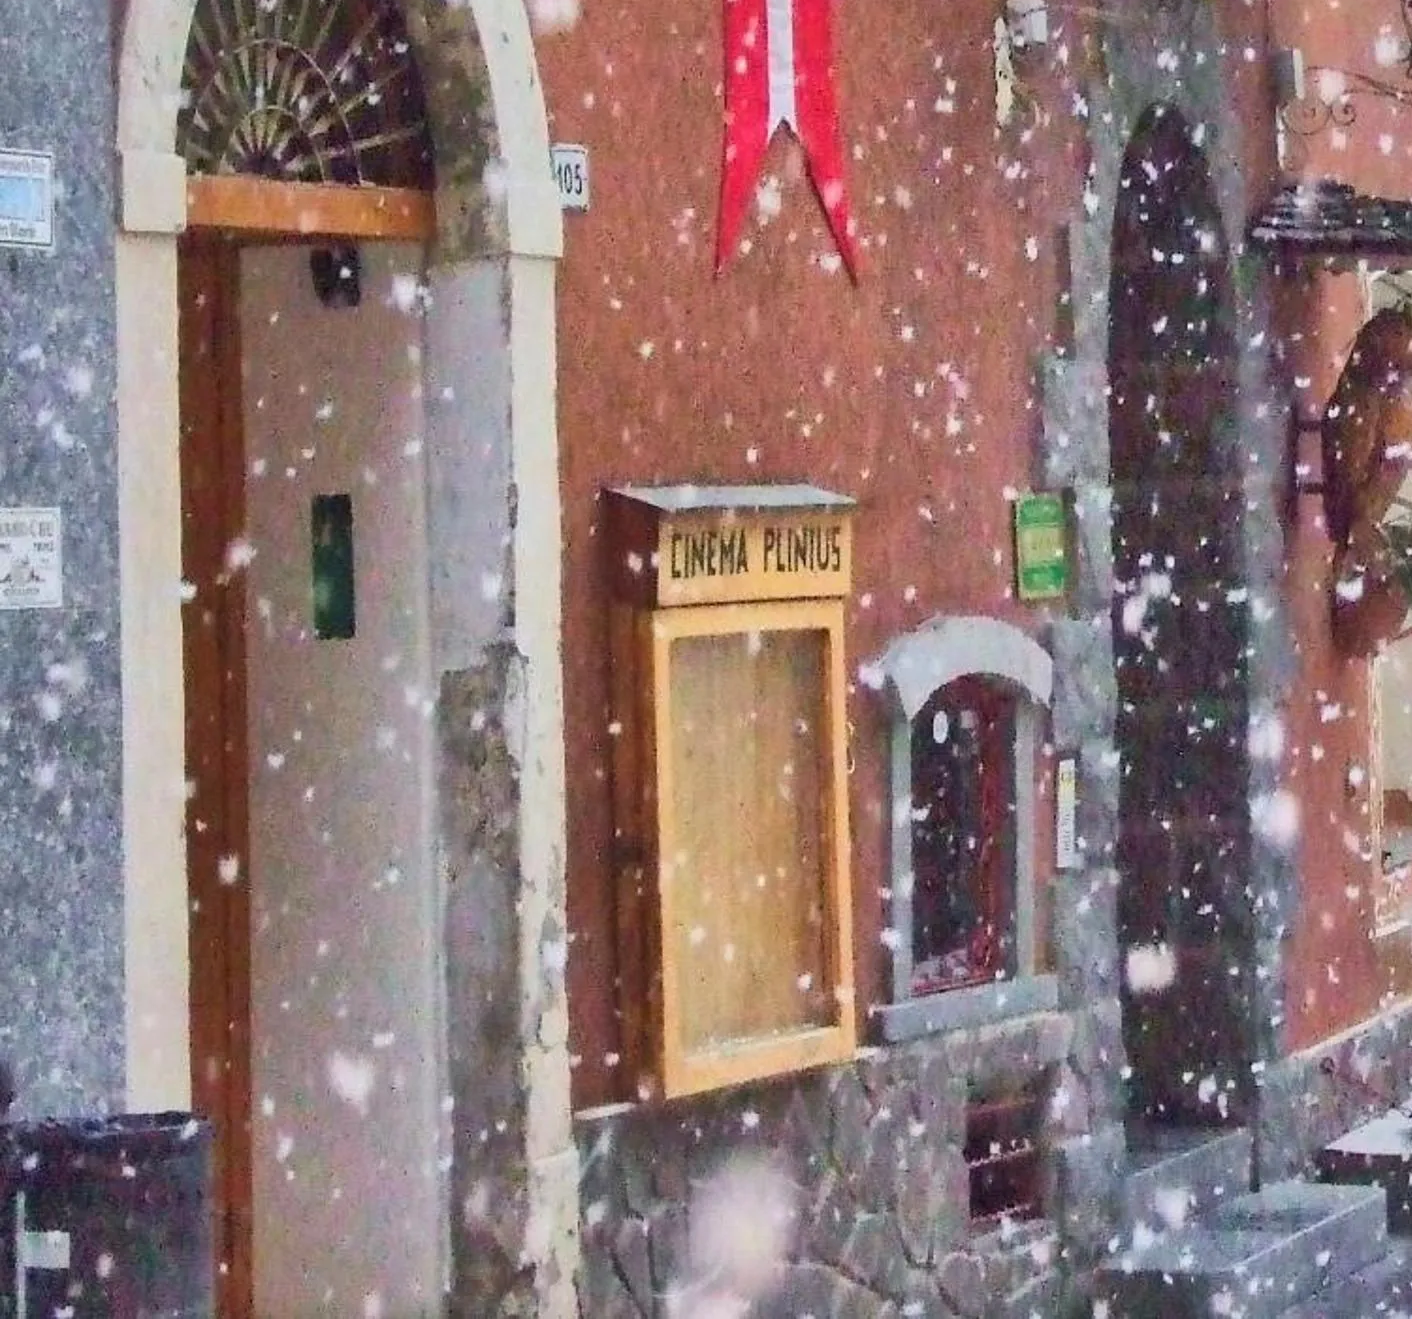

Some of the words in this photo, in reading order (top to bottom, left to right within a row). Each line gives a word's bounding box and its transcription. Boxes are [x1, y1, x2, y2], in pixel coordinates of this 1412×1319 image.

[557, 163, 583, 195] 105
[670, 530, 749, 579] CINEMA
[763, 526, 842, 573] PLINIUS
